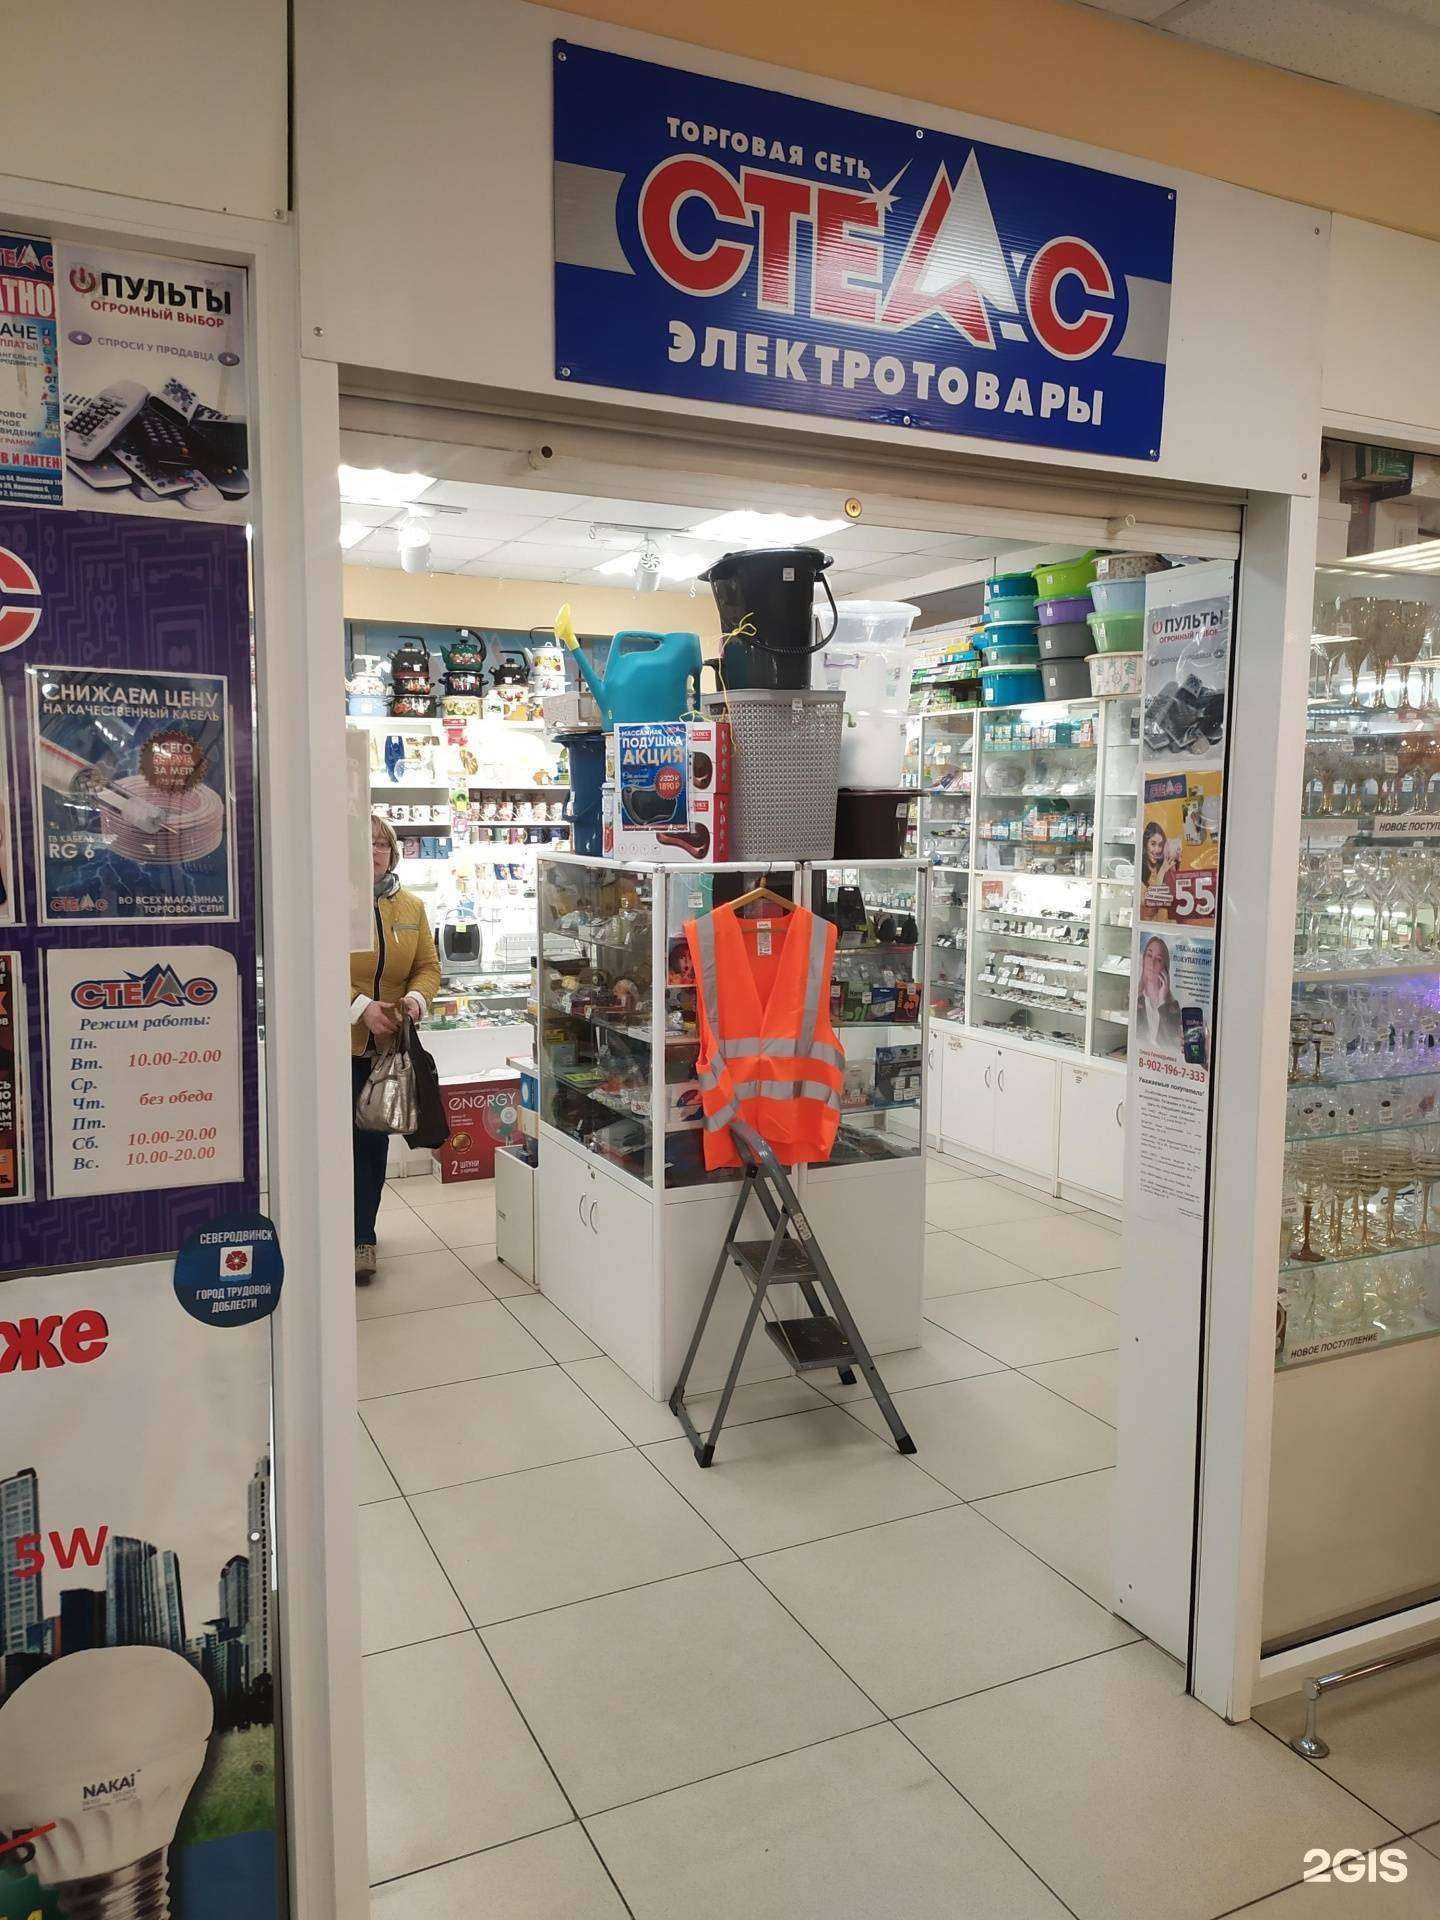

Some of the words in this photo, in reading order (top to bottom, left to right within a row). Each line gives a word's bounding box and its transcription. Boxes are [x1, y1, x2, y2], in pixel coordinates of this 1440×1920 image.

[666, 116, 804, 166] ТОРГОВАЯ
[814, 150, 872, 181] СЕТЬ
[101, 272, 231, 315] ПУЛЬТЫ
[90, 299, 173, 321] ОГРОМНЫЙ
[177, 311, 225, 328] ВЫБОР
[98, 336, 144, 351] СПРОСИ
[147, 344, 153, 352] У
[156, 345, 215, 362] ПРОДАВЦА
[667, 319, 1105, 427] ЭЛЕКТРОТОВАРЫ
[1165, 610, 1223, 633] ПУЛЬТЫ
[42, 683, 158, 705] СНИЖАЕМ
[165, 689, 218, 708] ЦЕНУ
[43, 703, 64, 715] НА
[67, 704, 169, 719] КАЧЕСТВЕННЫЙ
[172, 708, 220, 722] КАБЕЛЬ
[622, 735, 683, 749] ПОДУШКА
[622, 747, 683, 766] АКЦИЯ
[1378, 822, 1408, 832] НОВОЕ
[49, 843, 78, 859] RG
[84, 843, 96, 860] 6
[118, 896, 134, 905] ВО
[135, 896, 162, 905] ВСЕХ
[164, 895, 225, 905] МАГАЗИНАХ
[1175, 876, 1215, 916] 55
[80, 1018, 139, 1031] Режим
[143, 1014, 211, 1031] работы:
[70, 1037, 98, 1050] Пн.
[70, 1057, 103, 1071] Вт.
[128, 1049, 222, 1068] 10.00-20.00
[70, 1077, 98, 1093] Ср.
[73, 1097, 105, 1110] Чт.
[139, 1092, 164, 1106] без
[168, 1089, 213, 1104] обеда
[72, 1117, 106, 1131] Пт.
[72, 1136, 99, 1151] Сб.
[128, 1126, 217, 1146] 10.00-20.00
[73, 1157, 100, 1171] Вс.
[126, 1146, 216, 1166] 10.00-20.00
[200, 1229, 273, 1245] СЕВЕРОДВИНСК
[196, 1288, 225, 1301] ГОРОД
[227, 1283, 272, 1299] ТРУДОВОЙ
[211, 1298, 257, 1313] ДОБЛЕСТИ
[1290, 1345, 1320, 1359] НОВОЕ
[1320, 1332, 1379, 1353] ПОСТУПЛЕНИЕ
[14, 1525, 109, 1579] 5W
